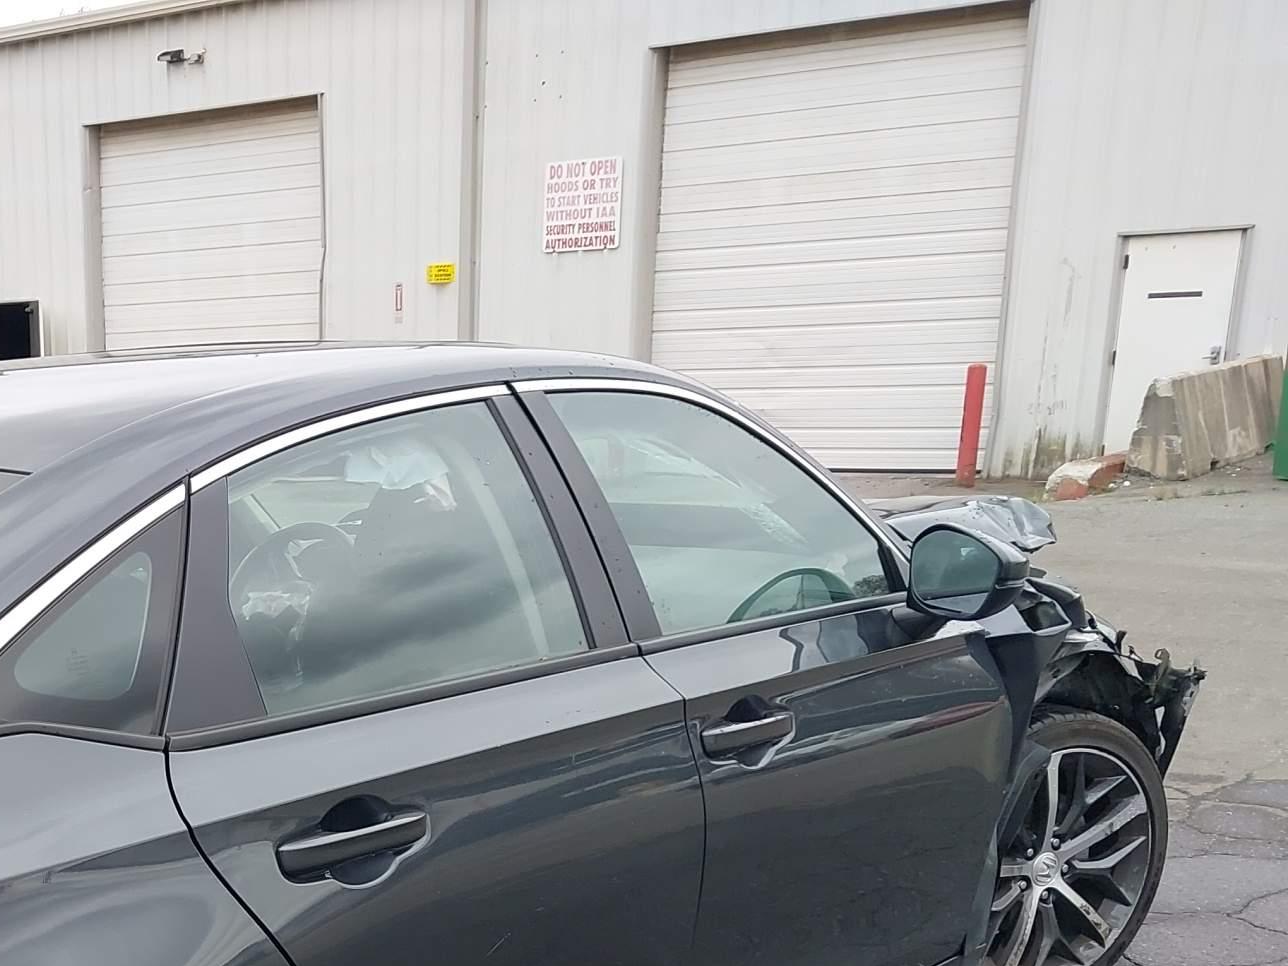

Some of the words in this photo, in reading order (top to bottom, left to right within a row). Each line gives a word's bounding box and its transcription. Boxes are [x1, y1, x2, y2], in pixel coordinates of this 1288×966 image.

[549, 163, 563, 180] DO
[566, 162, 586, 178] NOT
[589, 158, 617, 176] OPEN
[547, 180, 579, 194] HOODS
[582, 178, 596, 191] OR
[599, 176, 618, 189] TRY
[546, 196, 556, 209] TO
[558, 194, 581, 208] START
[583, 191, 619, 205] VEHICLES
[546, 207, 593, 222] WITHOUT
[596, 206, 616, 218] IAA
[545, 223, 576, 236] SECURITY
[578, 220, 616, 234] PERSONNEL
[545, 235, 616, 250] AUTHORIZATION
